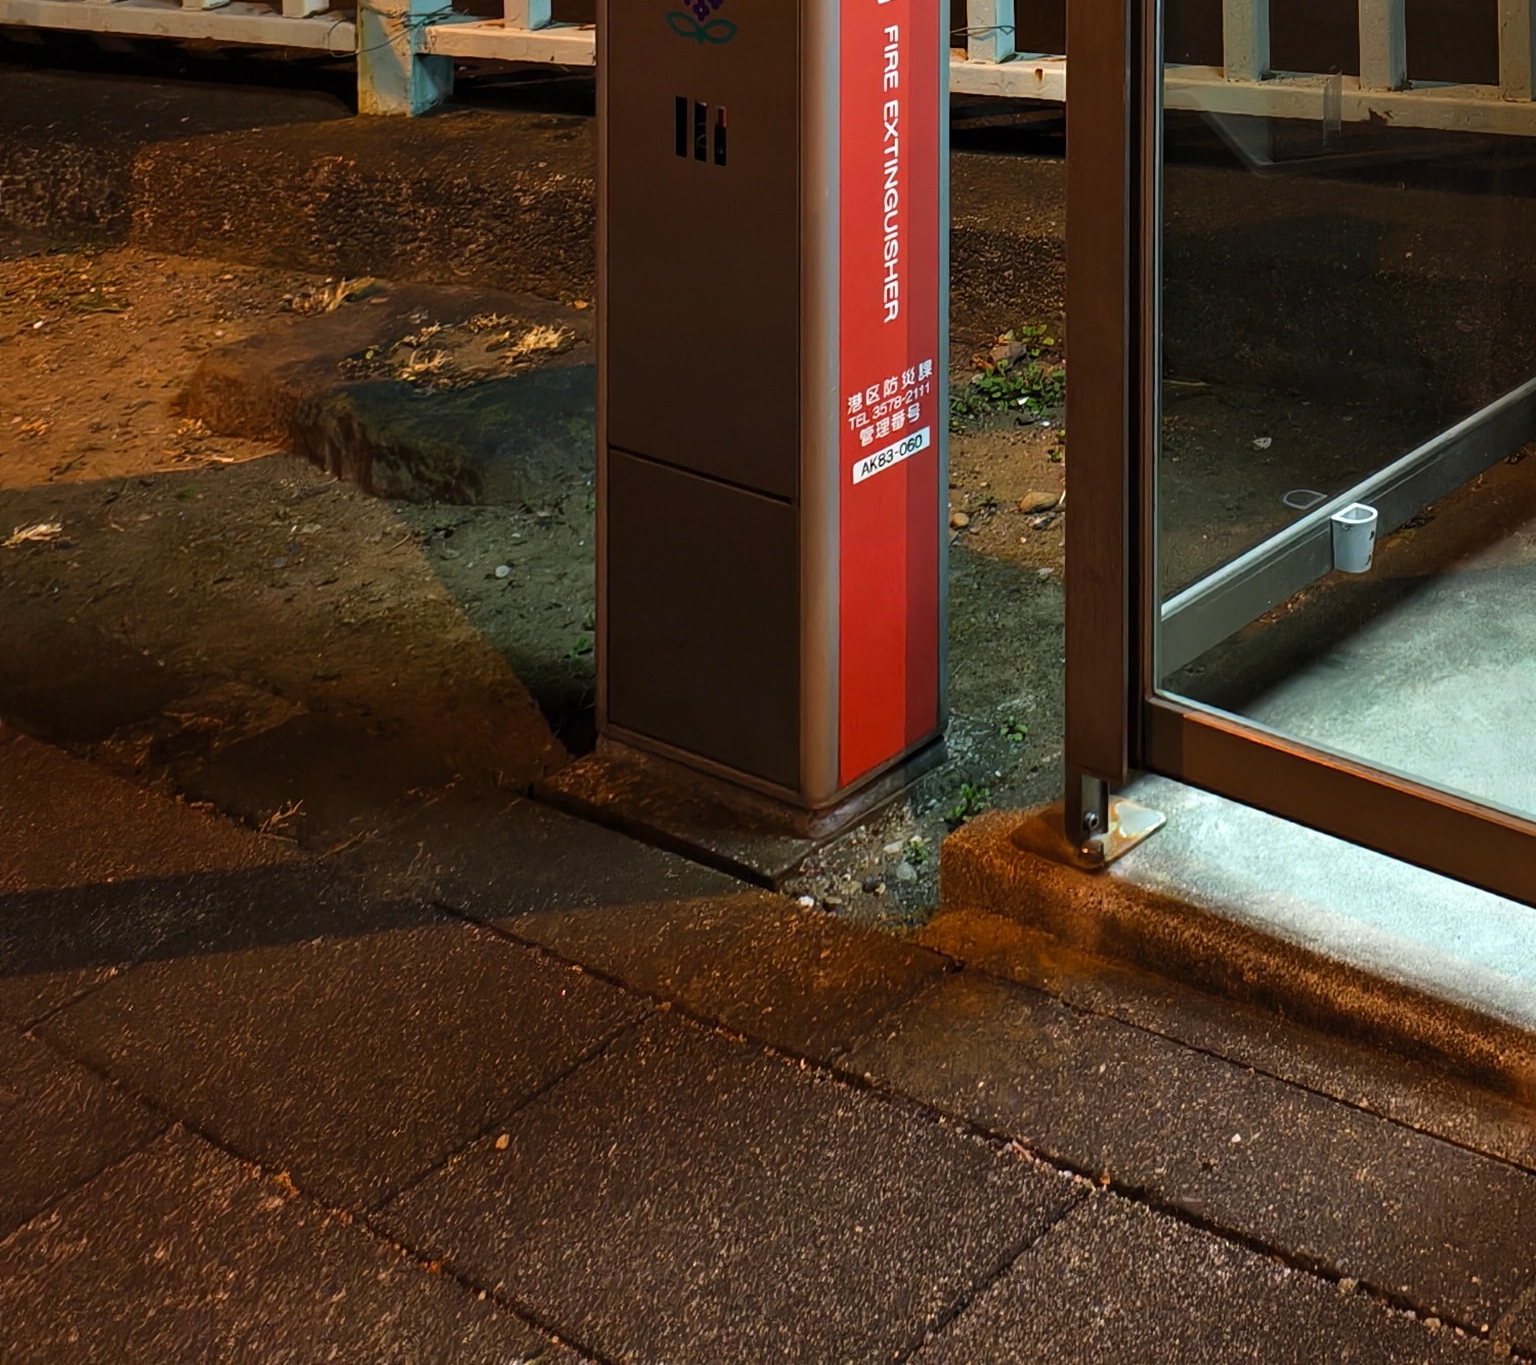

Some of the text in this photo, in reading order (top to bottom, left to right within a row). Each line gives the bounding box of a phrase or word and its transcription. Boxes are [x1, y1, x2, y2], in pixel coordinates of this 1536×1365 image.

[882, 24, 899, 324] FIRE EXTINGUISHER
[847, 358, 933, 416] 港区防災課
[848, 381, 931, 431] TEL 3578-2111
[858, 401, 921, 448] 管理番号
[860, 433, 923, 477] AK83-060
